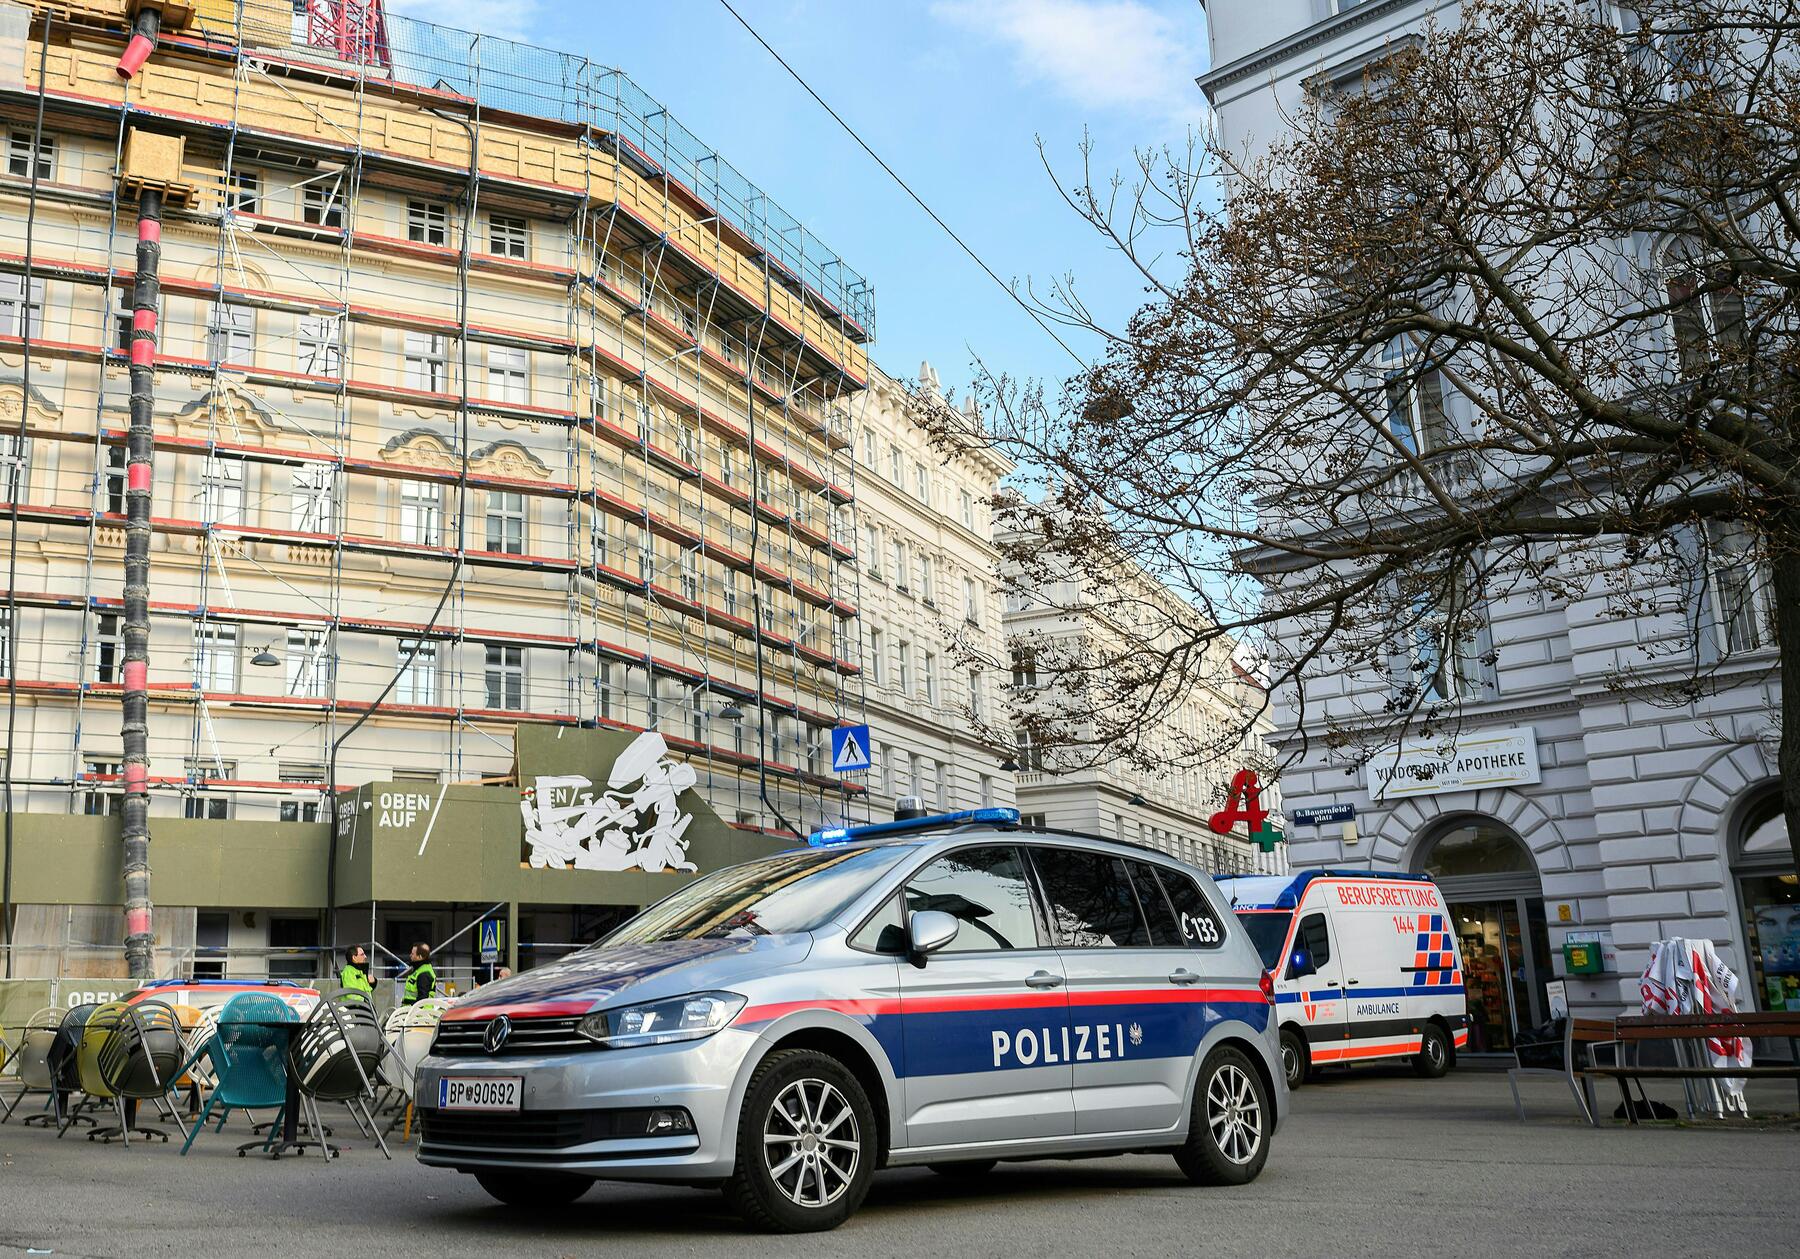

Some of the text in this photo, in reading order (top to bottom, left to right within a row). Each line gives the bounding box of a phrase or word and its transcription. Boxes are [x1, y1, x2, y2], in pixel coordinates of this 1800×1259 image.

[1456, 752, 1526, 773] APOTHEKE
[339, 800, 356, 819] OBEN
[380, 792, 430, 811] OBEN
[338, 818, 351, 837] AUF
[379, 811, 417, 828] AUF
[1314, 814, 1333, 824] platz
[1337, 885, 1439, 908] BERUFSRETTUNG
[1190, 917, 1219, 943] 133
[1393, 915, 1415, 934] 144
[1356, 1002, 1400, 1016] AMBULANCE
[991, 1023, 1124, 1067] POLIZEI
[449, 1082, 515, 1105] BP 90692
